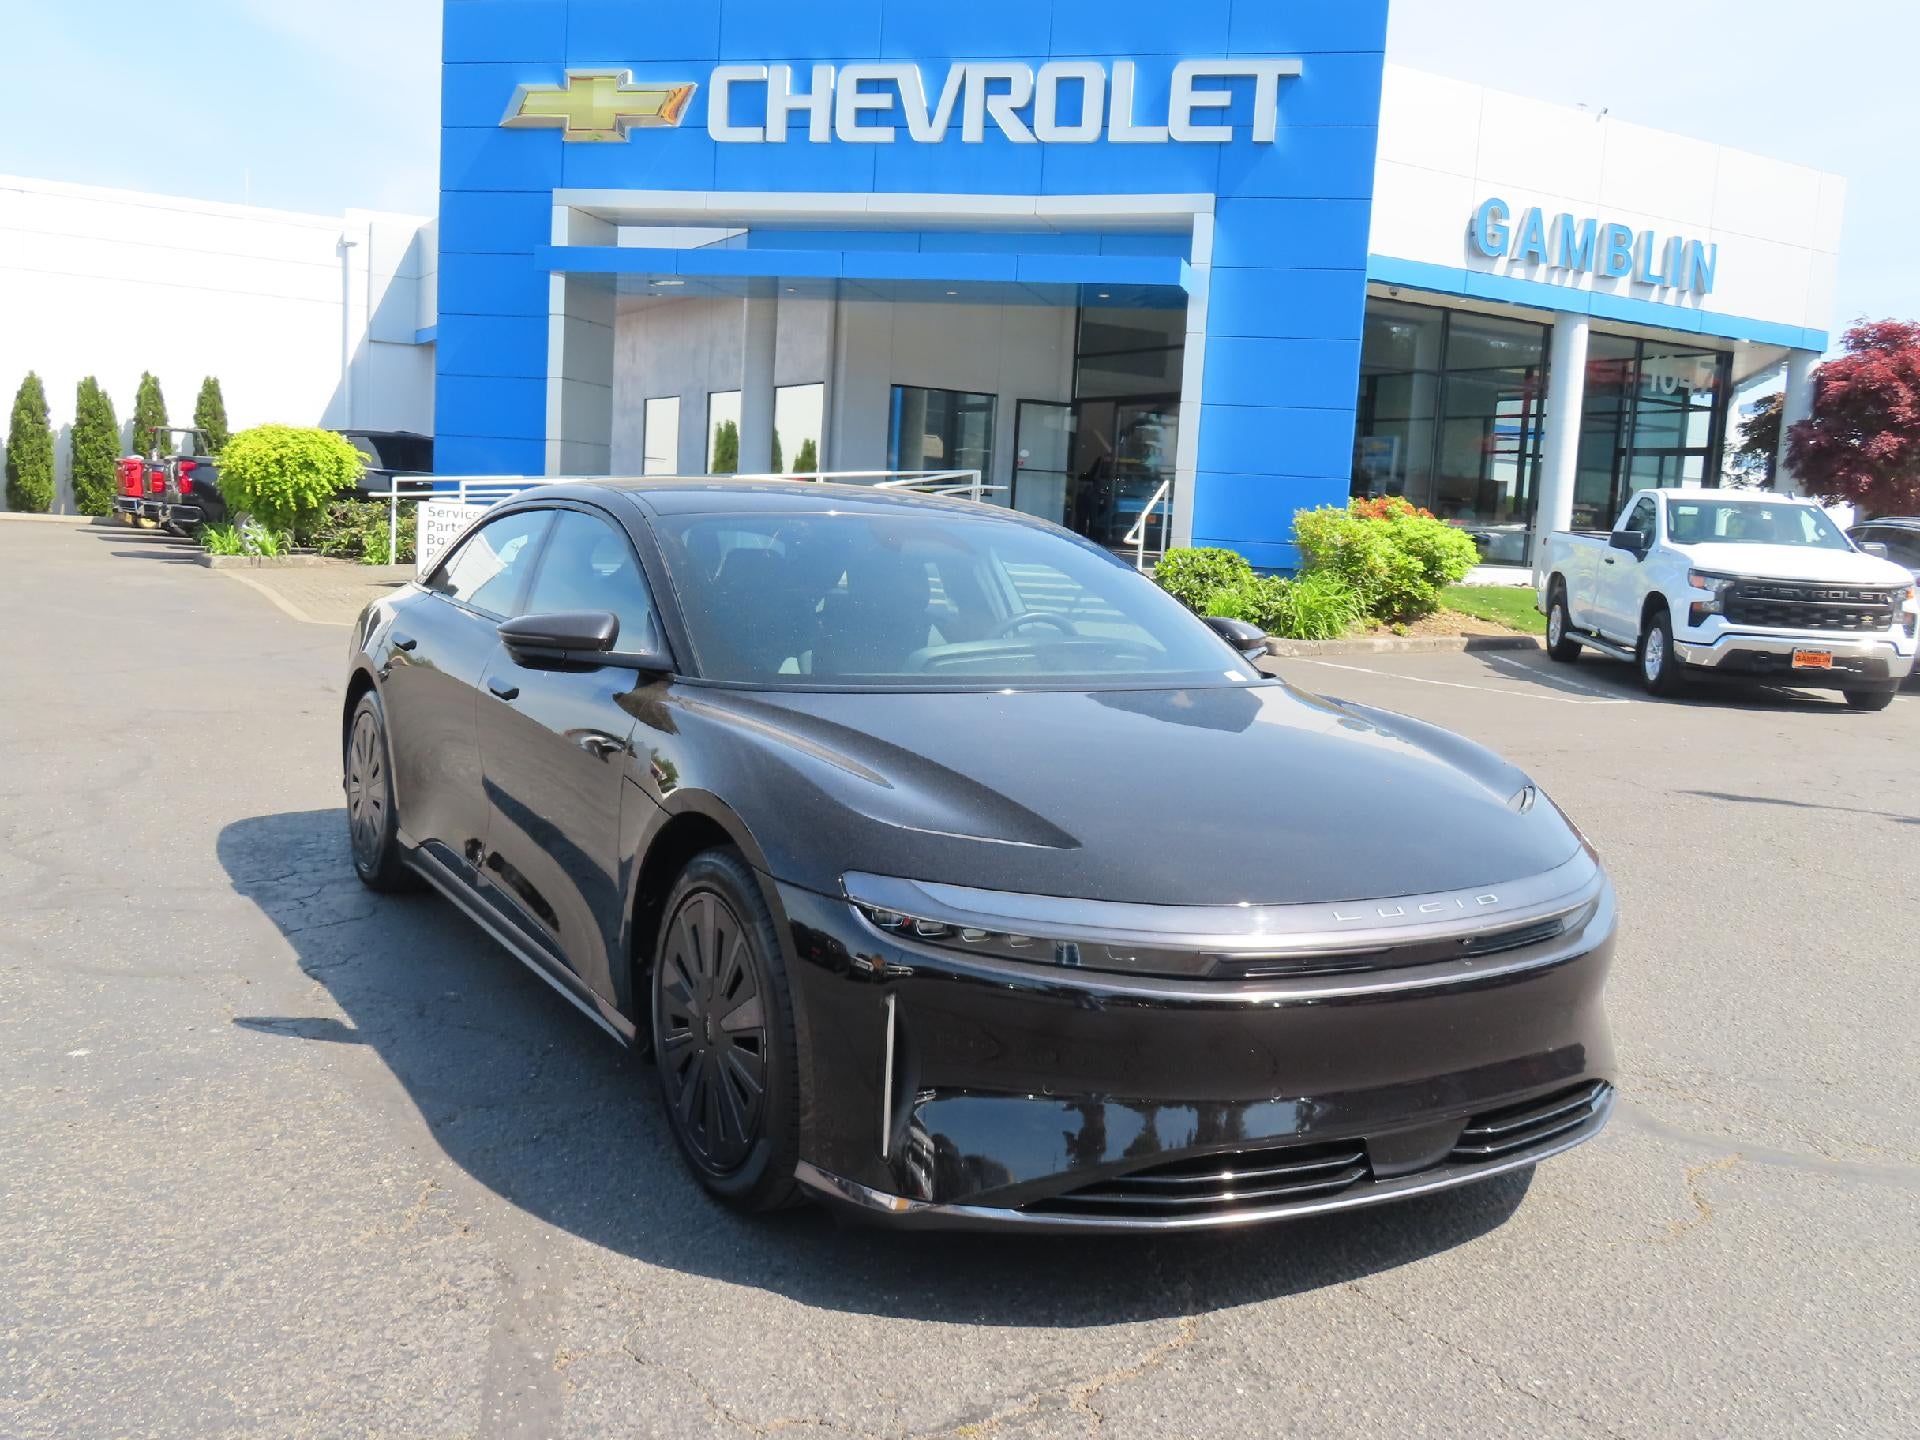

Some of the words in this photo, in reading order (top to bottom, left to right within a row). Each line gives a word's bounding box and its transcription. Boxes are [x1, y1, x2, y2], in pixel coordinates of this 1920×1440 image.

[708, 59, 1302, 145] CHEVROLET
[1473, 197, 1717, 295] GAMBLIN
[1743, 585, 1889, 602] CHEVROLET
[1332, 894, 1499, 921] LUCID
